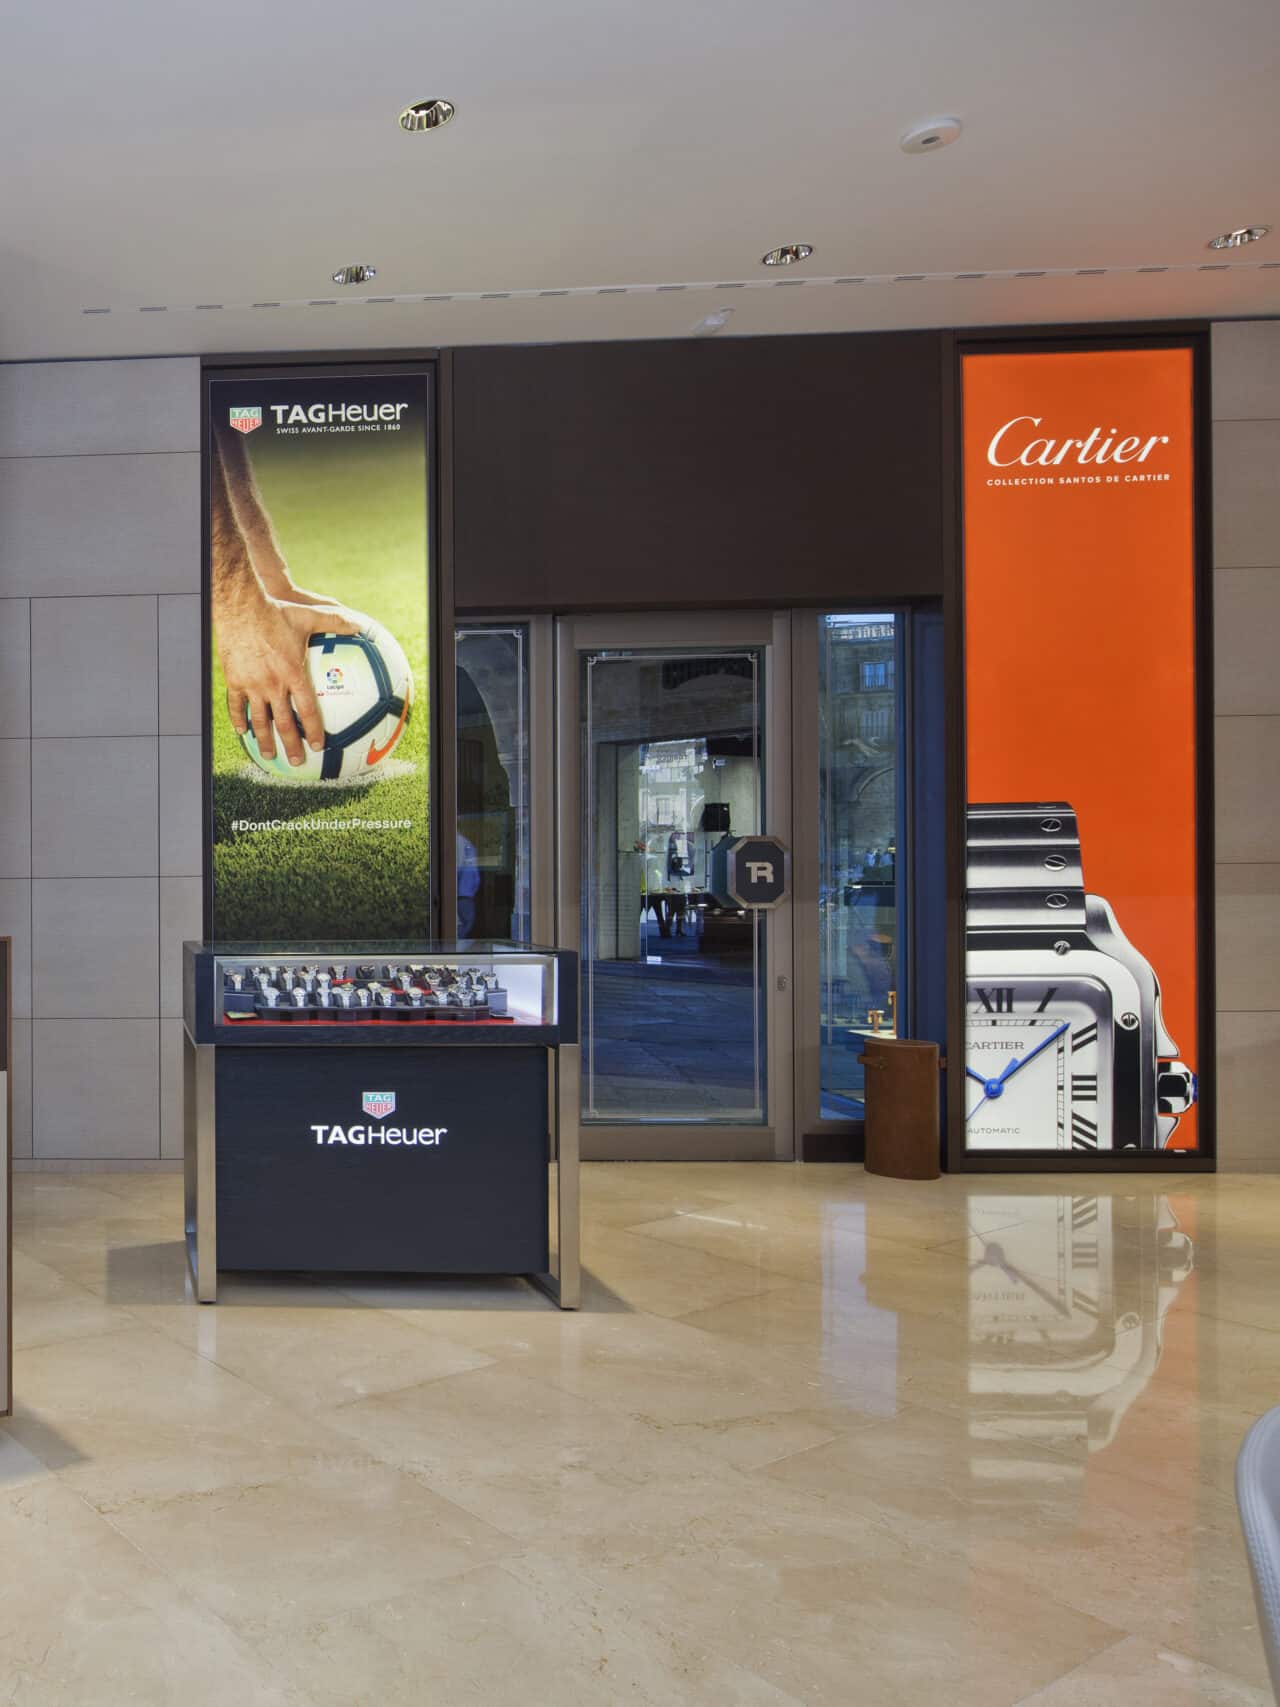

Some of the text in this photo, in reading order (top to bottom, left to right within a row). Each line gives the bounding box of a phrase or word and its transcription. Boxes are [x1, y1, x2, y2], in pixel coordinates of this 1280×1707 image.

[231, 409, 259, 418] TAG
[302, 425, 355, 433] AVANT-GARDE
[358, 424, 381, 432] SINCE
[383, 423, 401, 431] 1860
[987, 415, 1169, 467] Cartier
[986, 473, 1170, 487] COLLECTION SANTOS DE CARTIER
[231, 818, 412, 832] #DontCrackUnderPressure
[367, 1094, 392, 1102] TAG
[366, 1103, 392, 1113] HEUER
[967, 1127, 1021, 1135] AUTOMATIC
